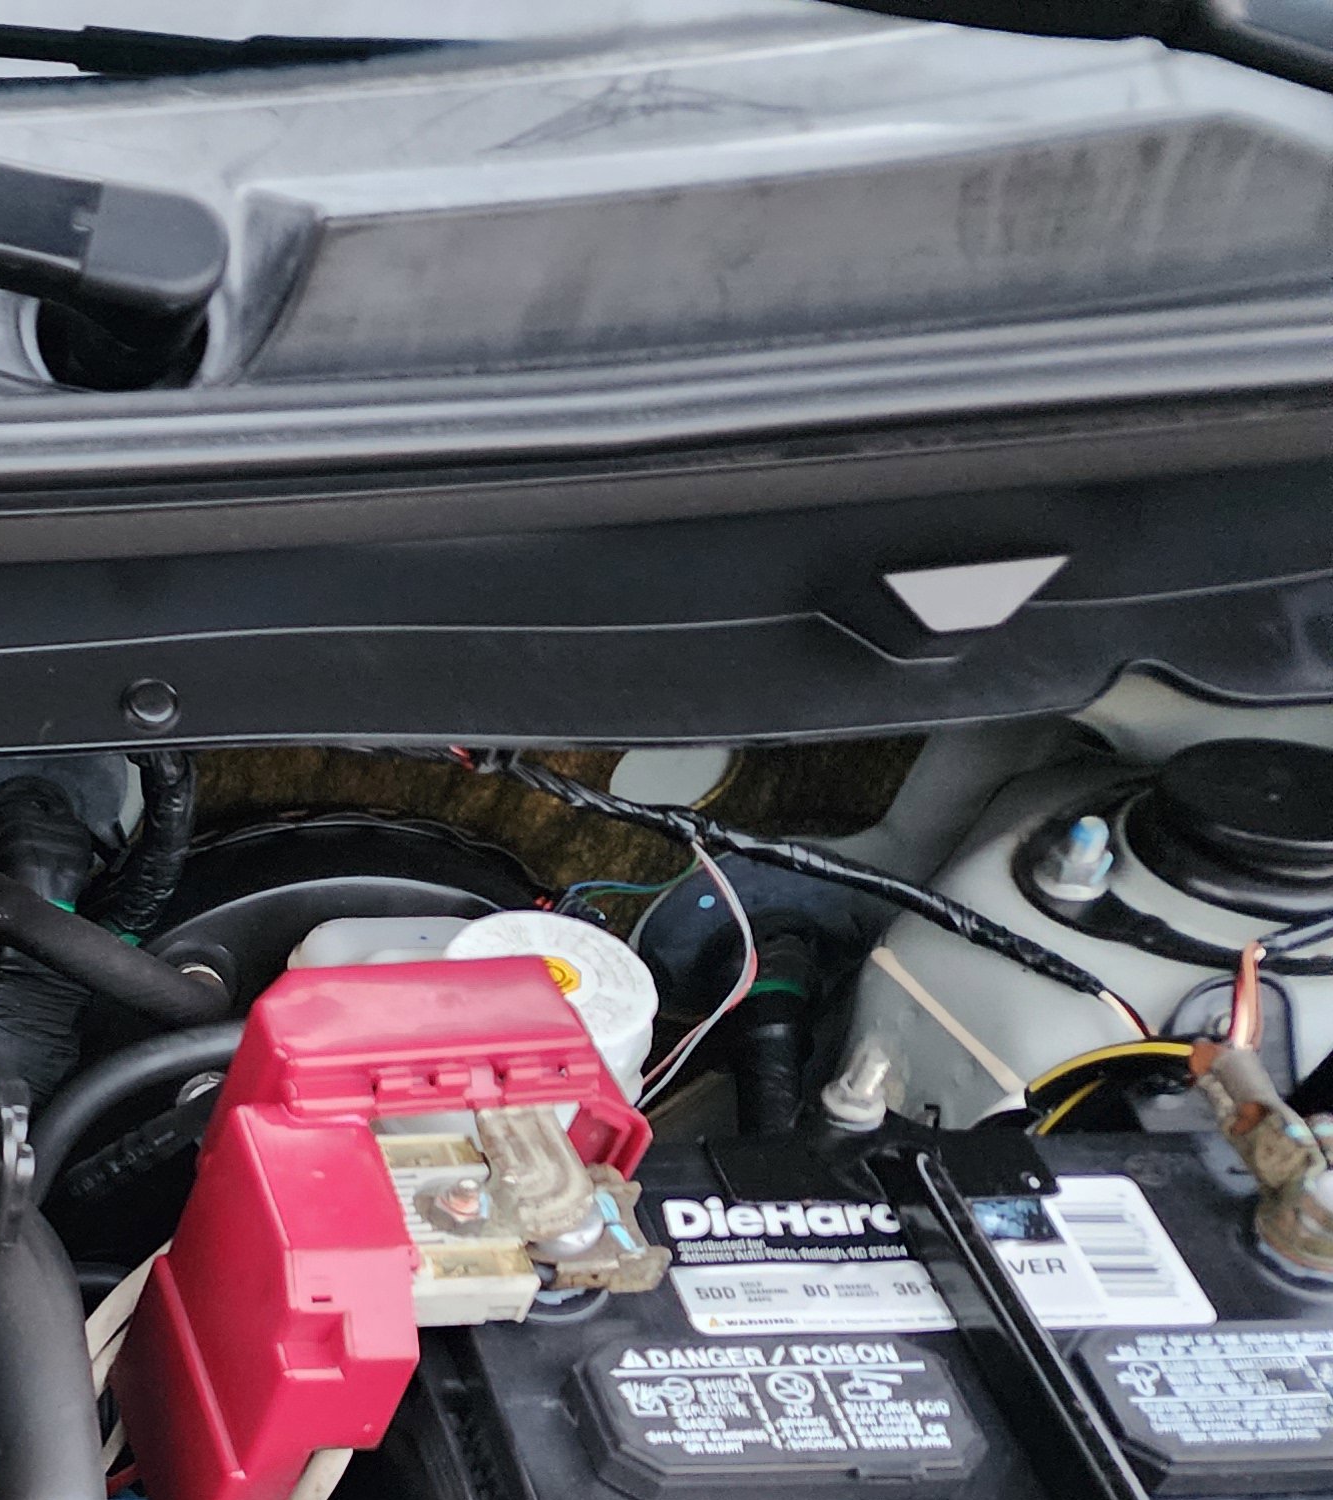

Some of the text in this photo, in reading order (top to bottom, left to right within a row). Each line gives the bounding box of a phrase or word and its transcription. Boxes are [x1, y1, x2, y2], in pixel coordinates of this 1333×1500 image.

[695, 1286, 737, 1301] 500
[645, 1346, 767, 1369] DANGER
[789, 1341, 901, 1366] POISON
